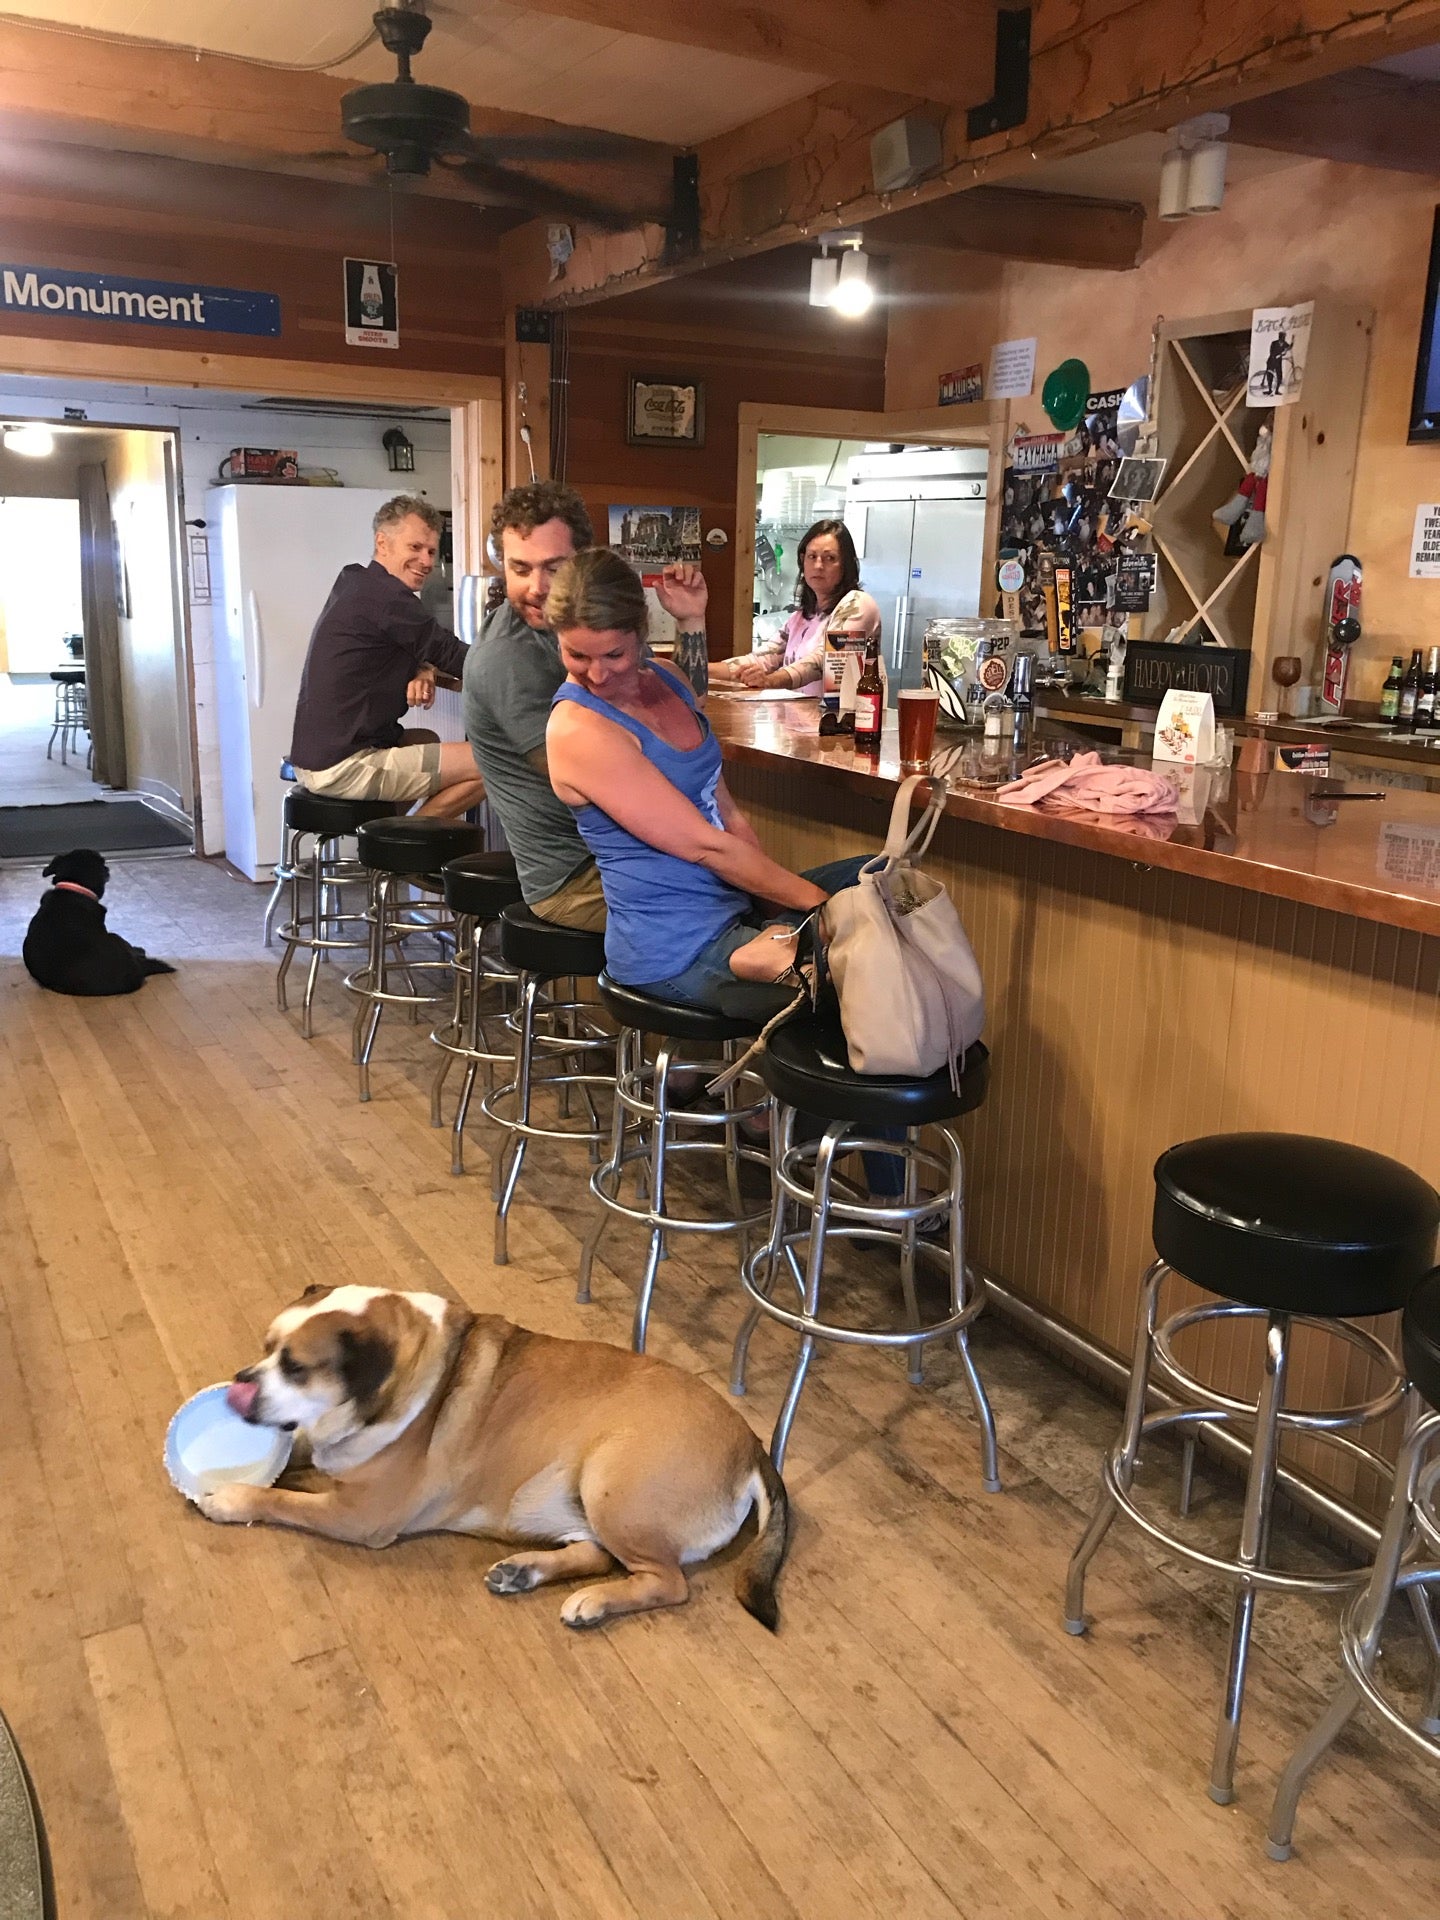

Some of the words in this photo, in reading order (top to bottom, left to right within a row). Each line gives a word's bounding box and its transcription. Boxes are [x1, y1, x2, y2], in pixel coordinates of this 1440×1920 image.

[3, 271, 205, 323] Monument
[1134, 658, 1176, 690] HAPPY
[1187, 663, 1228, 696] HOUR
